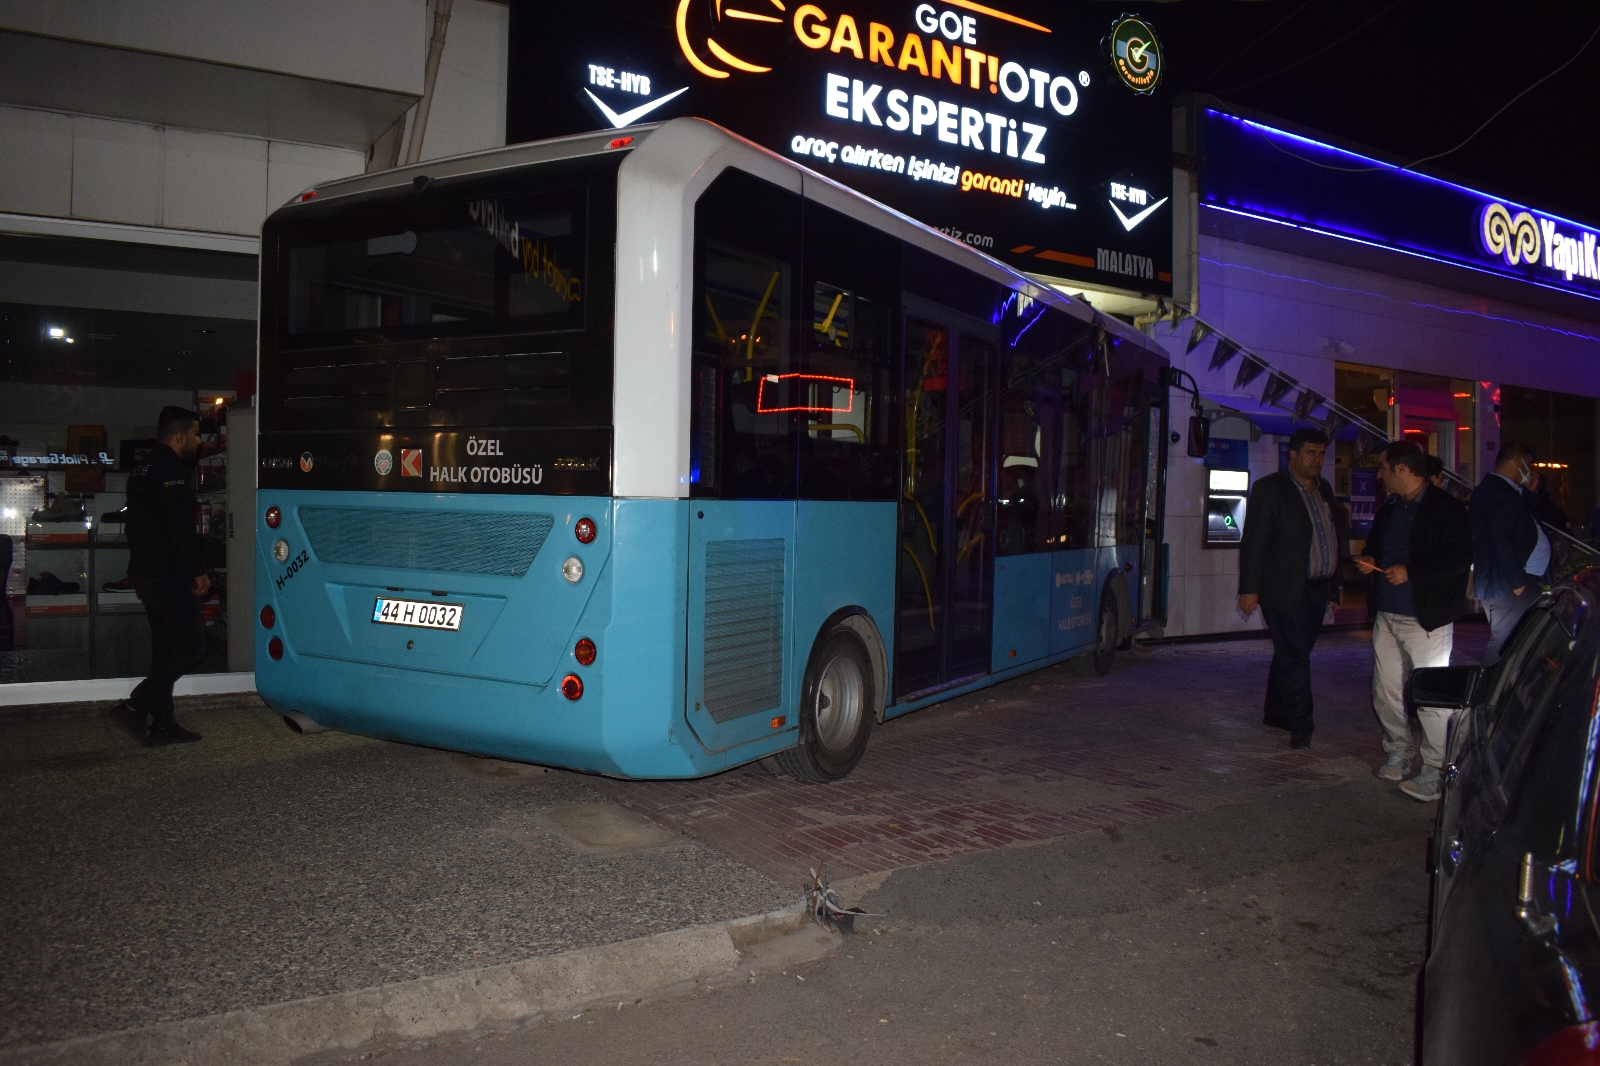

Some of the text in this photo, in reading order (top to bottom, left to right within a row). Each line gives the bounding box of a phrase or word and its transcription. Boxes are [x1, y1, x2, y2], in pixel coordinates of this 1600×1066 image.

[915, 3, 977, 45] GOE
[588, 63, 651, 96] TSE-HYB
[791, 135, 839, 163] araç
[961, 169, 1024, 198] garanti
[1097, 247, 1154, 280] MALATYA
[1540, 217, 1600, 281] YapıK
[466, 436, 504, 456] ÖZEL
[429, 463, 543, 485] HALK OTOBÜSÜ
[276, 550, 310, 591] H-0032
[381, 602, 400, 621] 44
[403, 604, 415, 622] H
[418, 606, 457, 626] 0032
